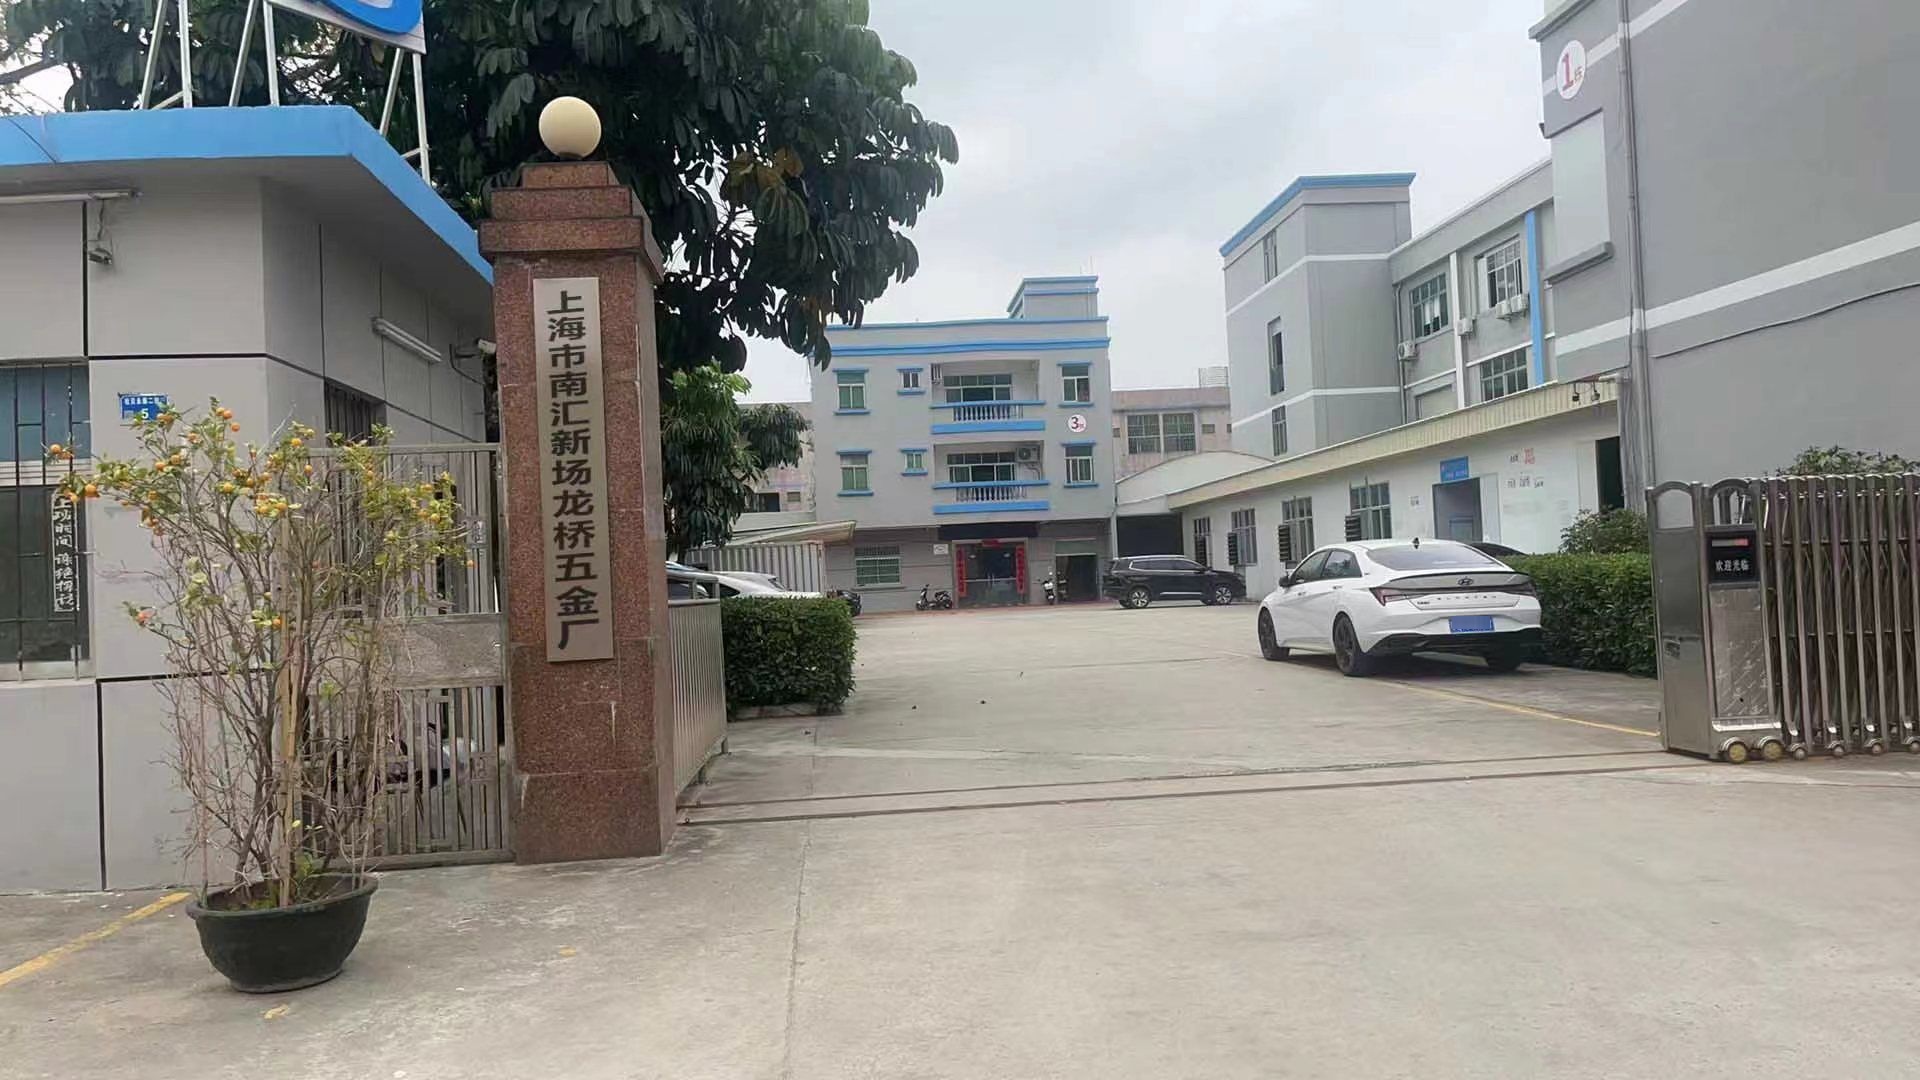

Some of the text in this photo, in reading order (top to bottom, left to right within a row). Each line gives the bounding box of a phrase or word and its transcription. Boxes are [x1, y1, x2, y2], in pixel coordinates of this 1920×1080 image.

[141, 408, 149, 419] 5
[546, 290, 600, 650] 上海市南汇新场龙桥五金厂
[1715, 559, 1750, 572] 欢迎光临
